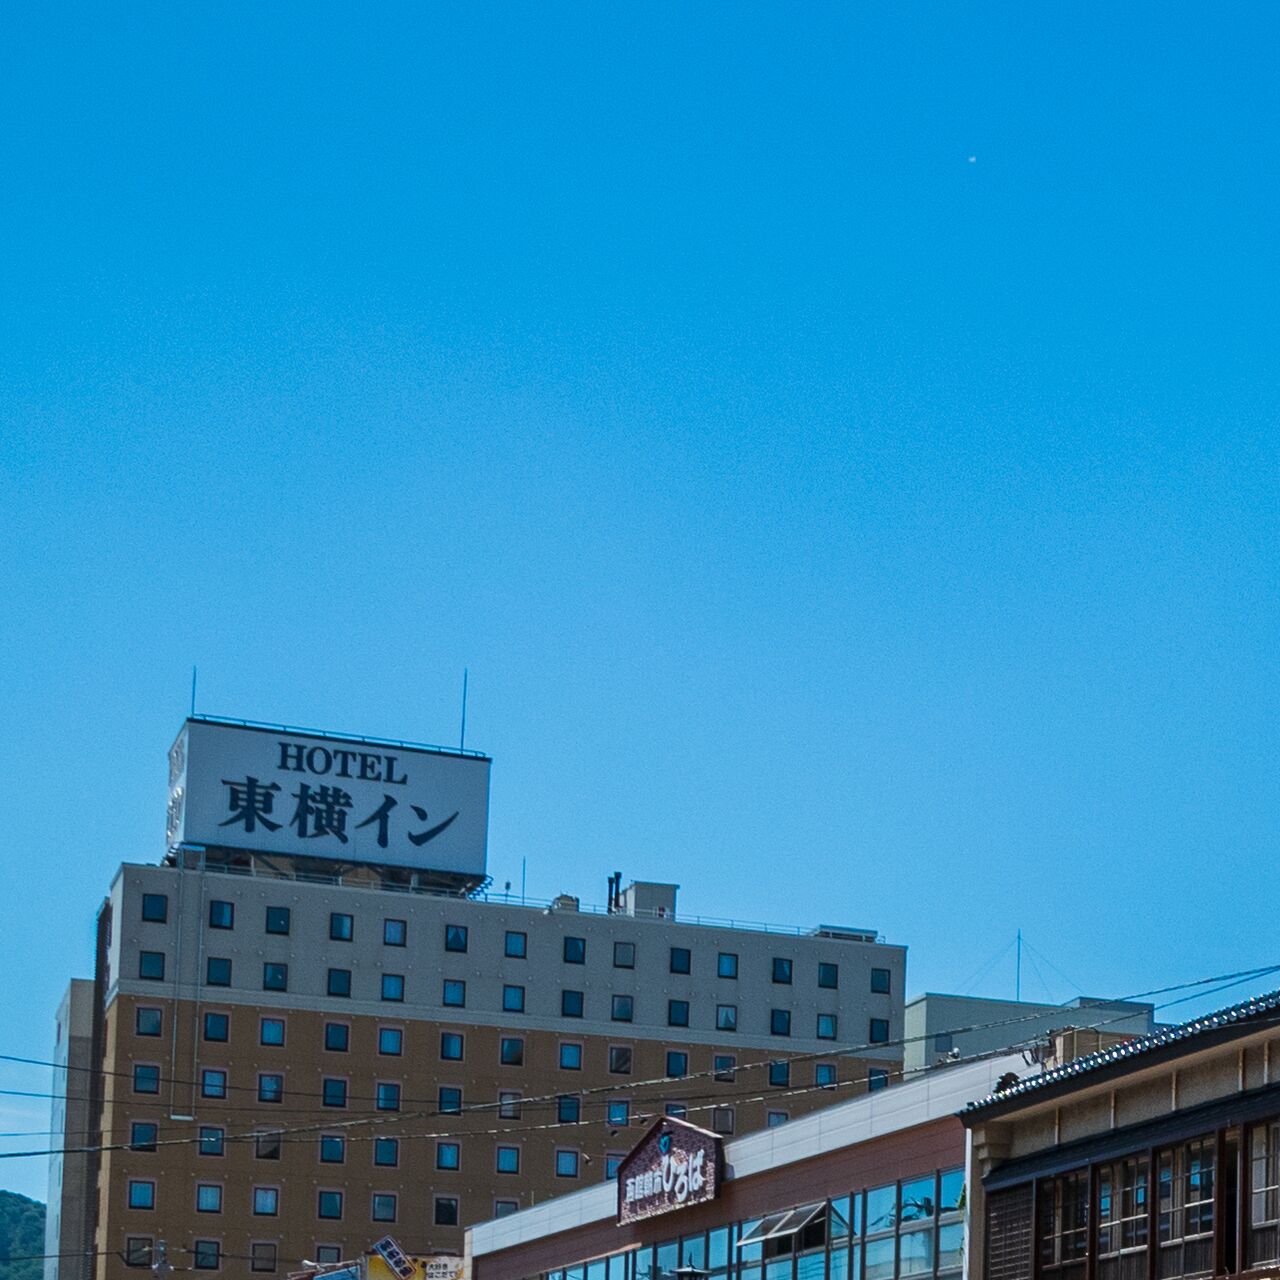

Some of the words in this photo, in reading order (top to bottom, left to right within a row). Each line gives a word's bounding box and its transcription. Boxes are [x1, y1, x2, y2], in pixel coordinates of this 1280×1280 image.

[277, 742, 408, 786] HOTEL
[217, 775, 459, 848] 東横イン
